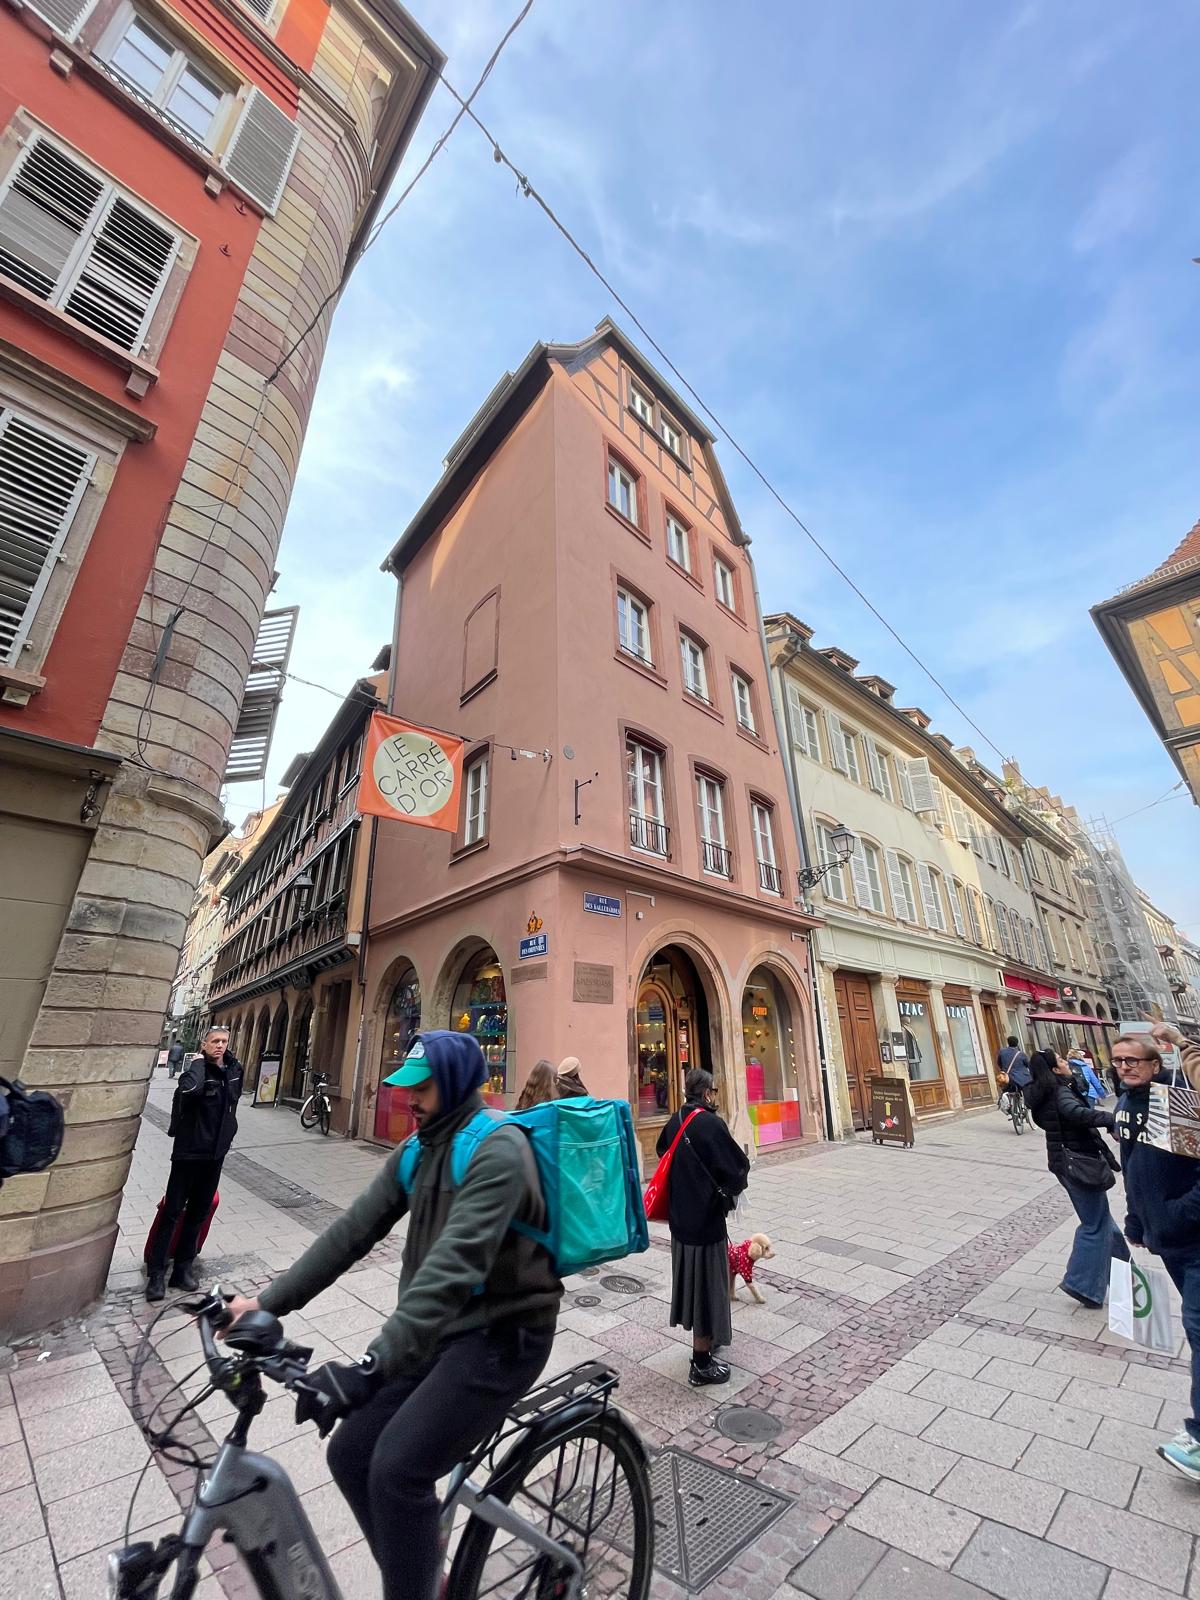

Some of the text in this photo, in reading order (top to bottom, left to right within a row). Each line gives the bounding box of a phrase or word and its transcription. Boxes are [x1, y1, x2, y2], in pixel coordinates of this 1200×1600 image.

[384, 737, 411, 763] LE
[378, 741, 446, 796] CARRÉ
[397, 770, 453, 814] D'OR
[599, 897, 607, 905] RUE
[899, 1002, 924, 1016] IZAC
[946, 1006, 967, 1019] IZAC
